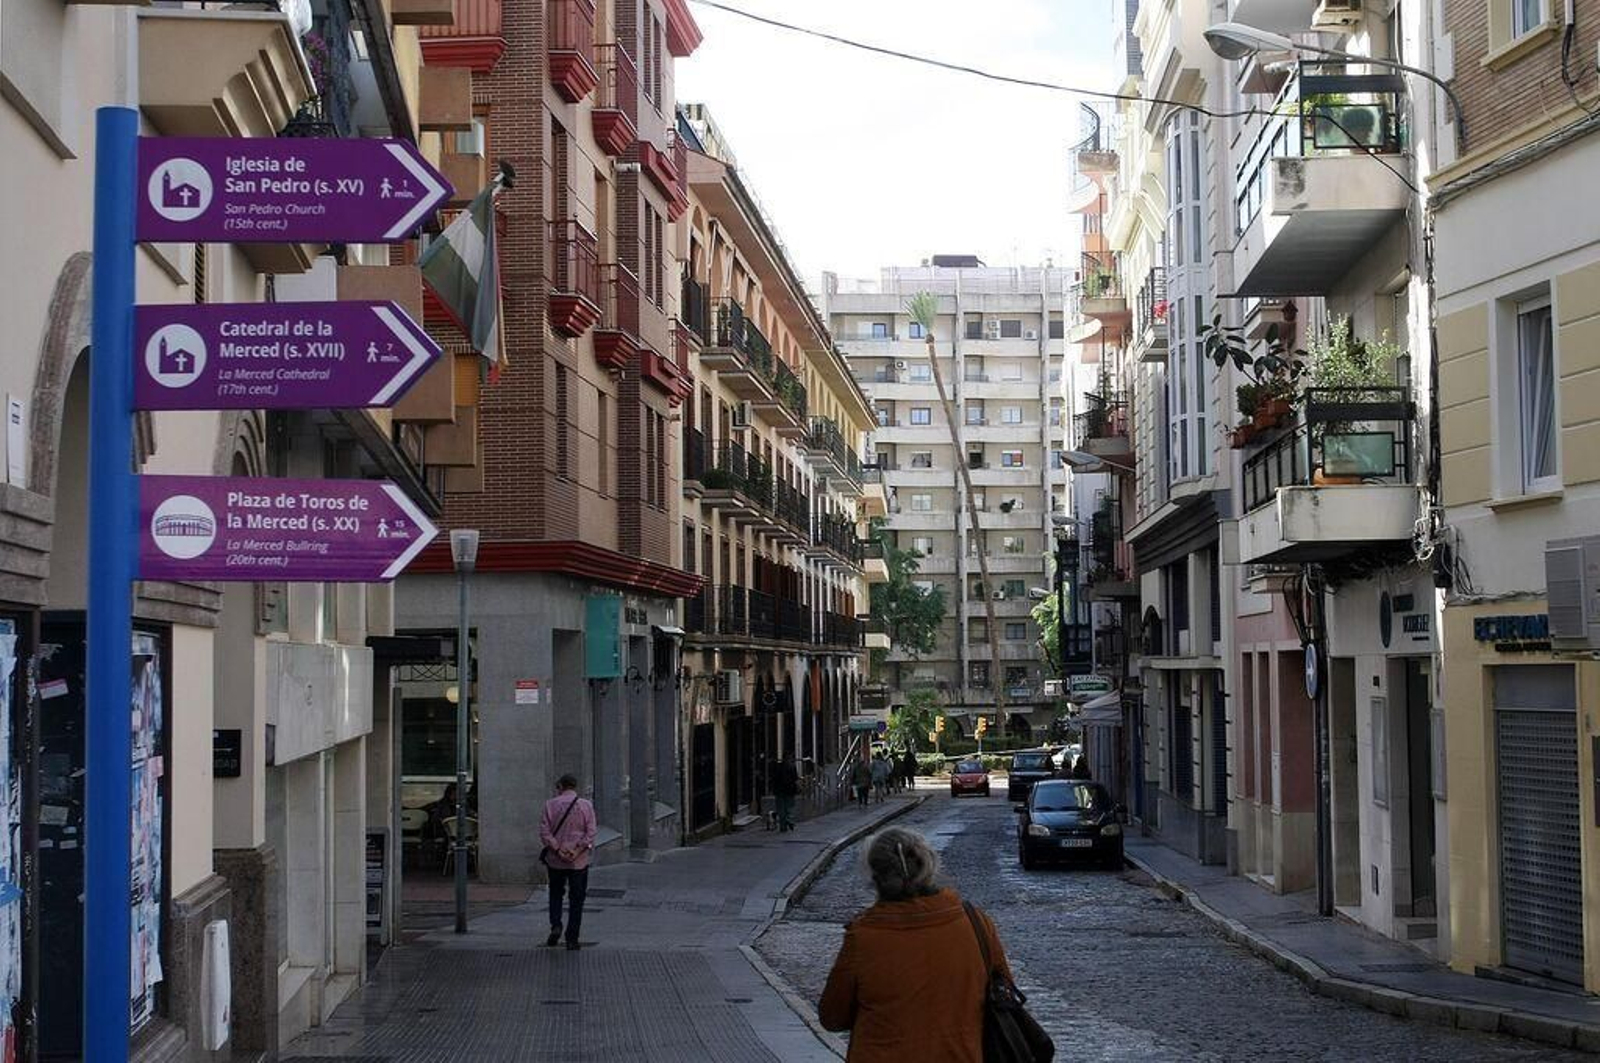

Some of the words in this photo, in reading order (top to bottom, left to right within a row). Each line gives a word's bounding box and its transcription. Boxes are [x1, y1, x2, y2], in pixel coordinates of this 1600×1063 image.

[226, 157, 280, 174] Iglesia
[285, 157, 305, 172] de
[225, 178, 258, 193] San
[262, 179, 309, 193] Pedro
[315, 179, 333, 196] (s.
[337, 179, 364, 196] XV)
[395, 190, 415, 199] min.
[225, 204, 245, 214] San
[249, 204, 282, 215] Pedro
[285, 204, 325, 215] Church
[224, 218, 255, 230] (15th
[257, 218, 287, 231] cent.)
[220, 320, 289, 336] Catedral
[294, 321, 314, 336] de
[318, 321, 332, 336] la
[219, 343, 279, 358] Merced
[284, 343, 302, 361] (s.
[307, 343, 344, 360] XVII)
[387, 343, 393, 351] 7
[381, 353, 400, 363] min.
[219, 369, 234, 380] La
[237, 369, 274, 380] Merced
[276, 368, 330, 380] Cathedral
[218, 384, 247, 395] (17th
[249, 384, 278, 396] cent.)
[228, 493, 272, 508] Plaza
[276, 494, 296, 509] de
[301, 495, 344, 510] Toros
[348, 495, 368, 510] de
[228, 513, 242, 528] la
[247, 515, 308, 530] Merced
[312, 517, 330, 533] (s.
[334, 517, 359, 534] XX)
[390, 530, 410, 539] min.
[227, 539, 240, 550] La
[244, 540, 283, 551] Merced
[286, 541, 328, 554] Bullring
[226, 554, 255, 566] (20th
[258, 555, 288, 567] cent.)
